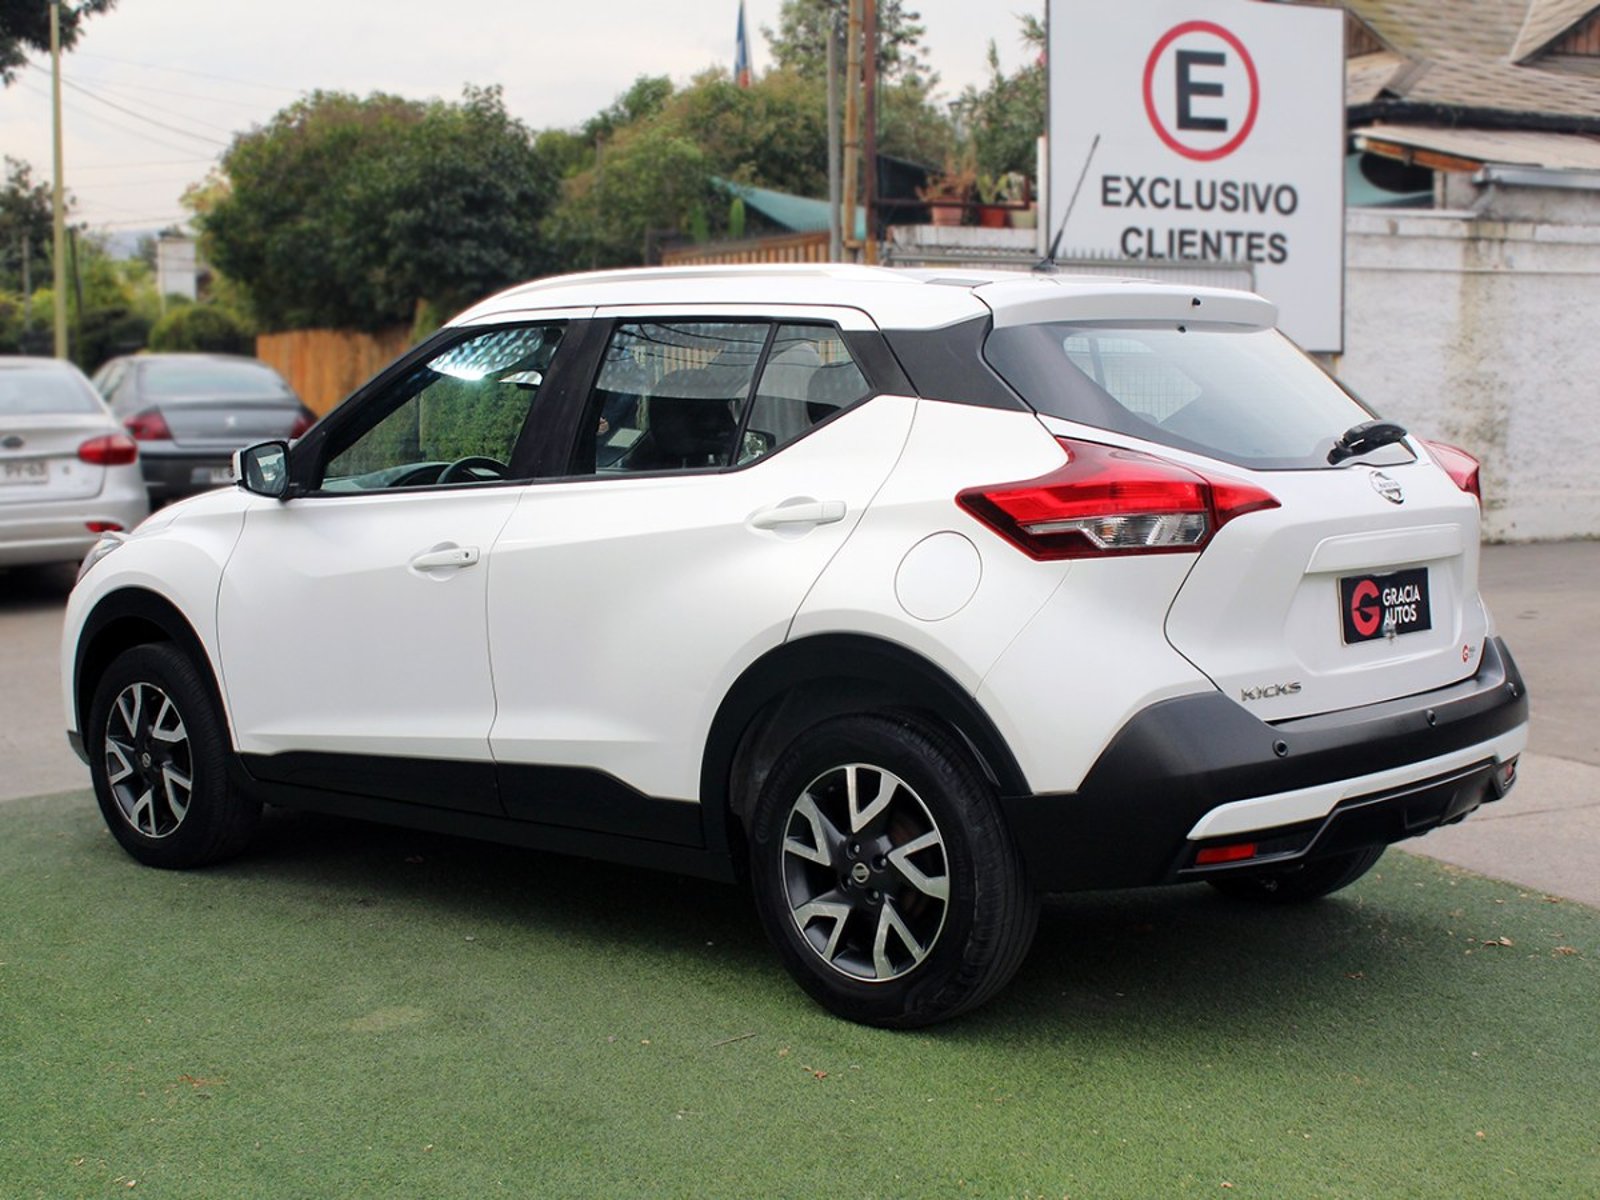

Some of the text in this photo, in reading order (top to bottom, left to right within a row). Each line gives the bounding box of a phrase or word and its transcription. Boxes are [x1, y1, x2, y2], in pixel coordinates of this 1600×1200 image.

[1176, 49, 1227, 132] E
[1101, 174, 1298, 216] EXCLUSIVO
[1120, 226, 1288, 265] CLIENTES
[1383, 585, 1421, 606] GRACIA
[1384, 604, 1417, 626] AUTOS
[1241, 681, 1301, 701] KICKS
